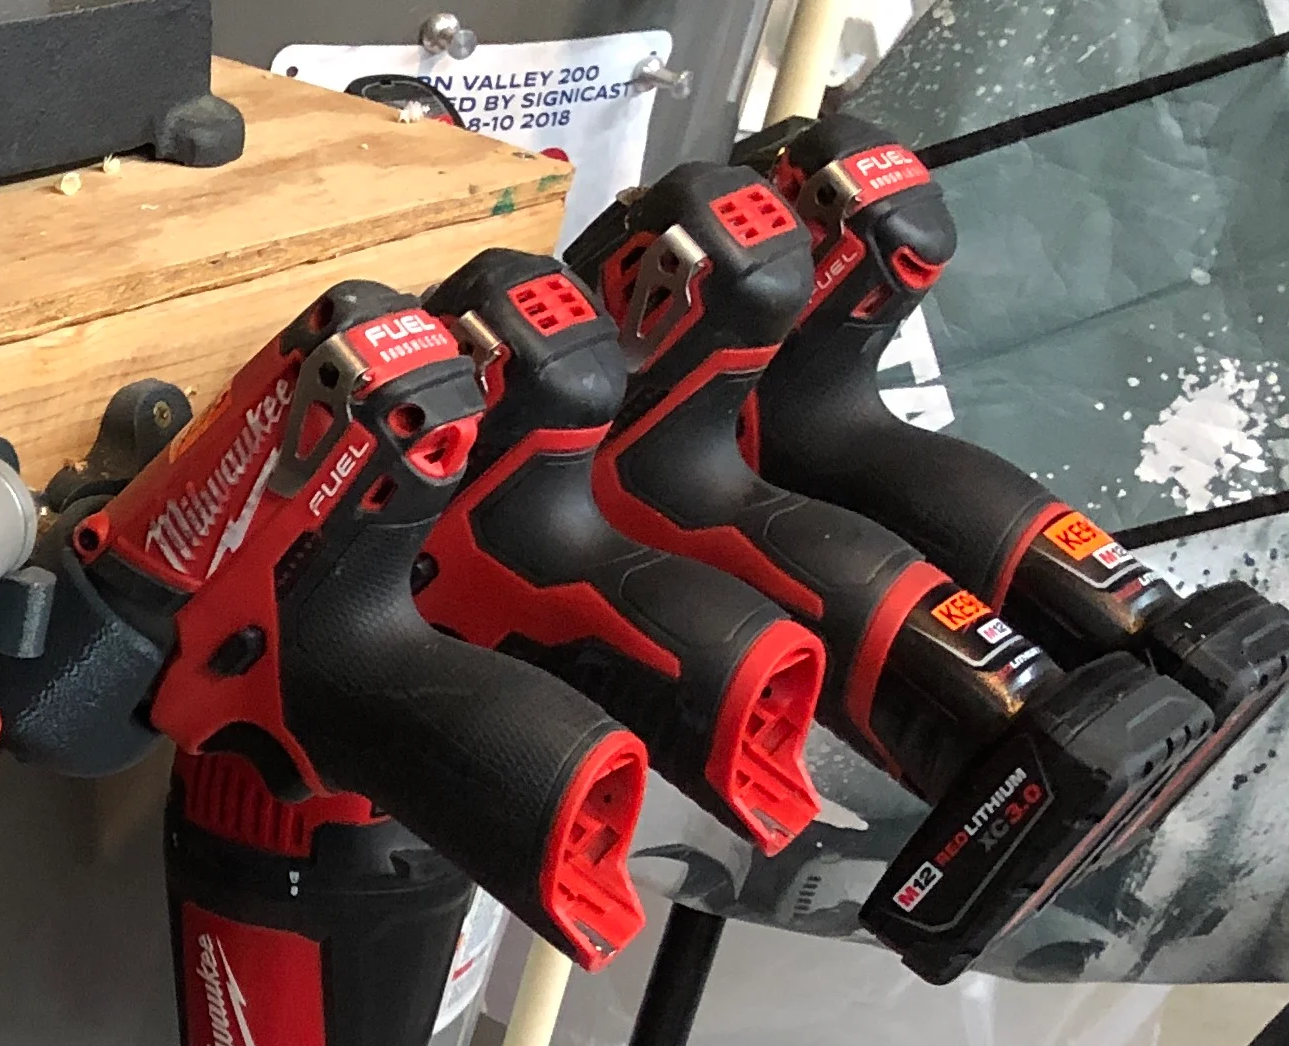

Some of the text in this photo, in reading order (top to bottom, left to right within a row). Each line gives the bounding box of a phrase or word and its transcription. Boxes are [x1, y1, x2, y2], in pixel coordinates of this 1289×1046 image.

[463, 70, 554, 91] VALLEY
[558, 65, 600, 85] 200
[484, 94, 516, 111] BY
[520, 81, 631, 110] SIGNICAST
[468, 110, 571, 133] 8-10 2018
[856, 151, 914, 177] FUEL
[364, 313, 436, 348] FUEL
[145, 379, 294, 575] Milwaukee
[308, 442, 370, 517] FUEL
[1055, 519, 1101, 551] KE9
[938, 592, 983, 625] KE9
[984, 620, 1010, 641] M12
[897, 866, 938, 907] M12
